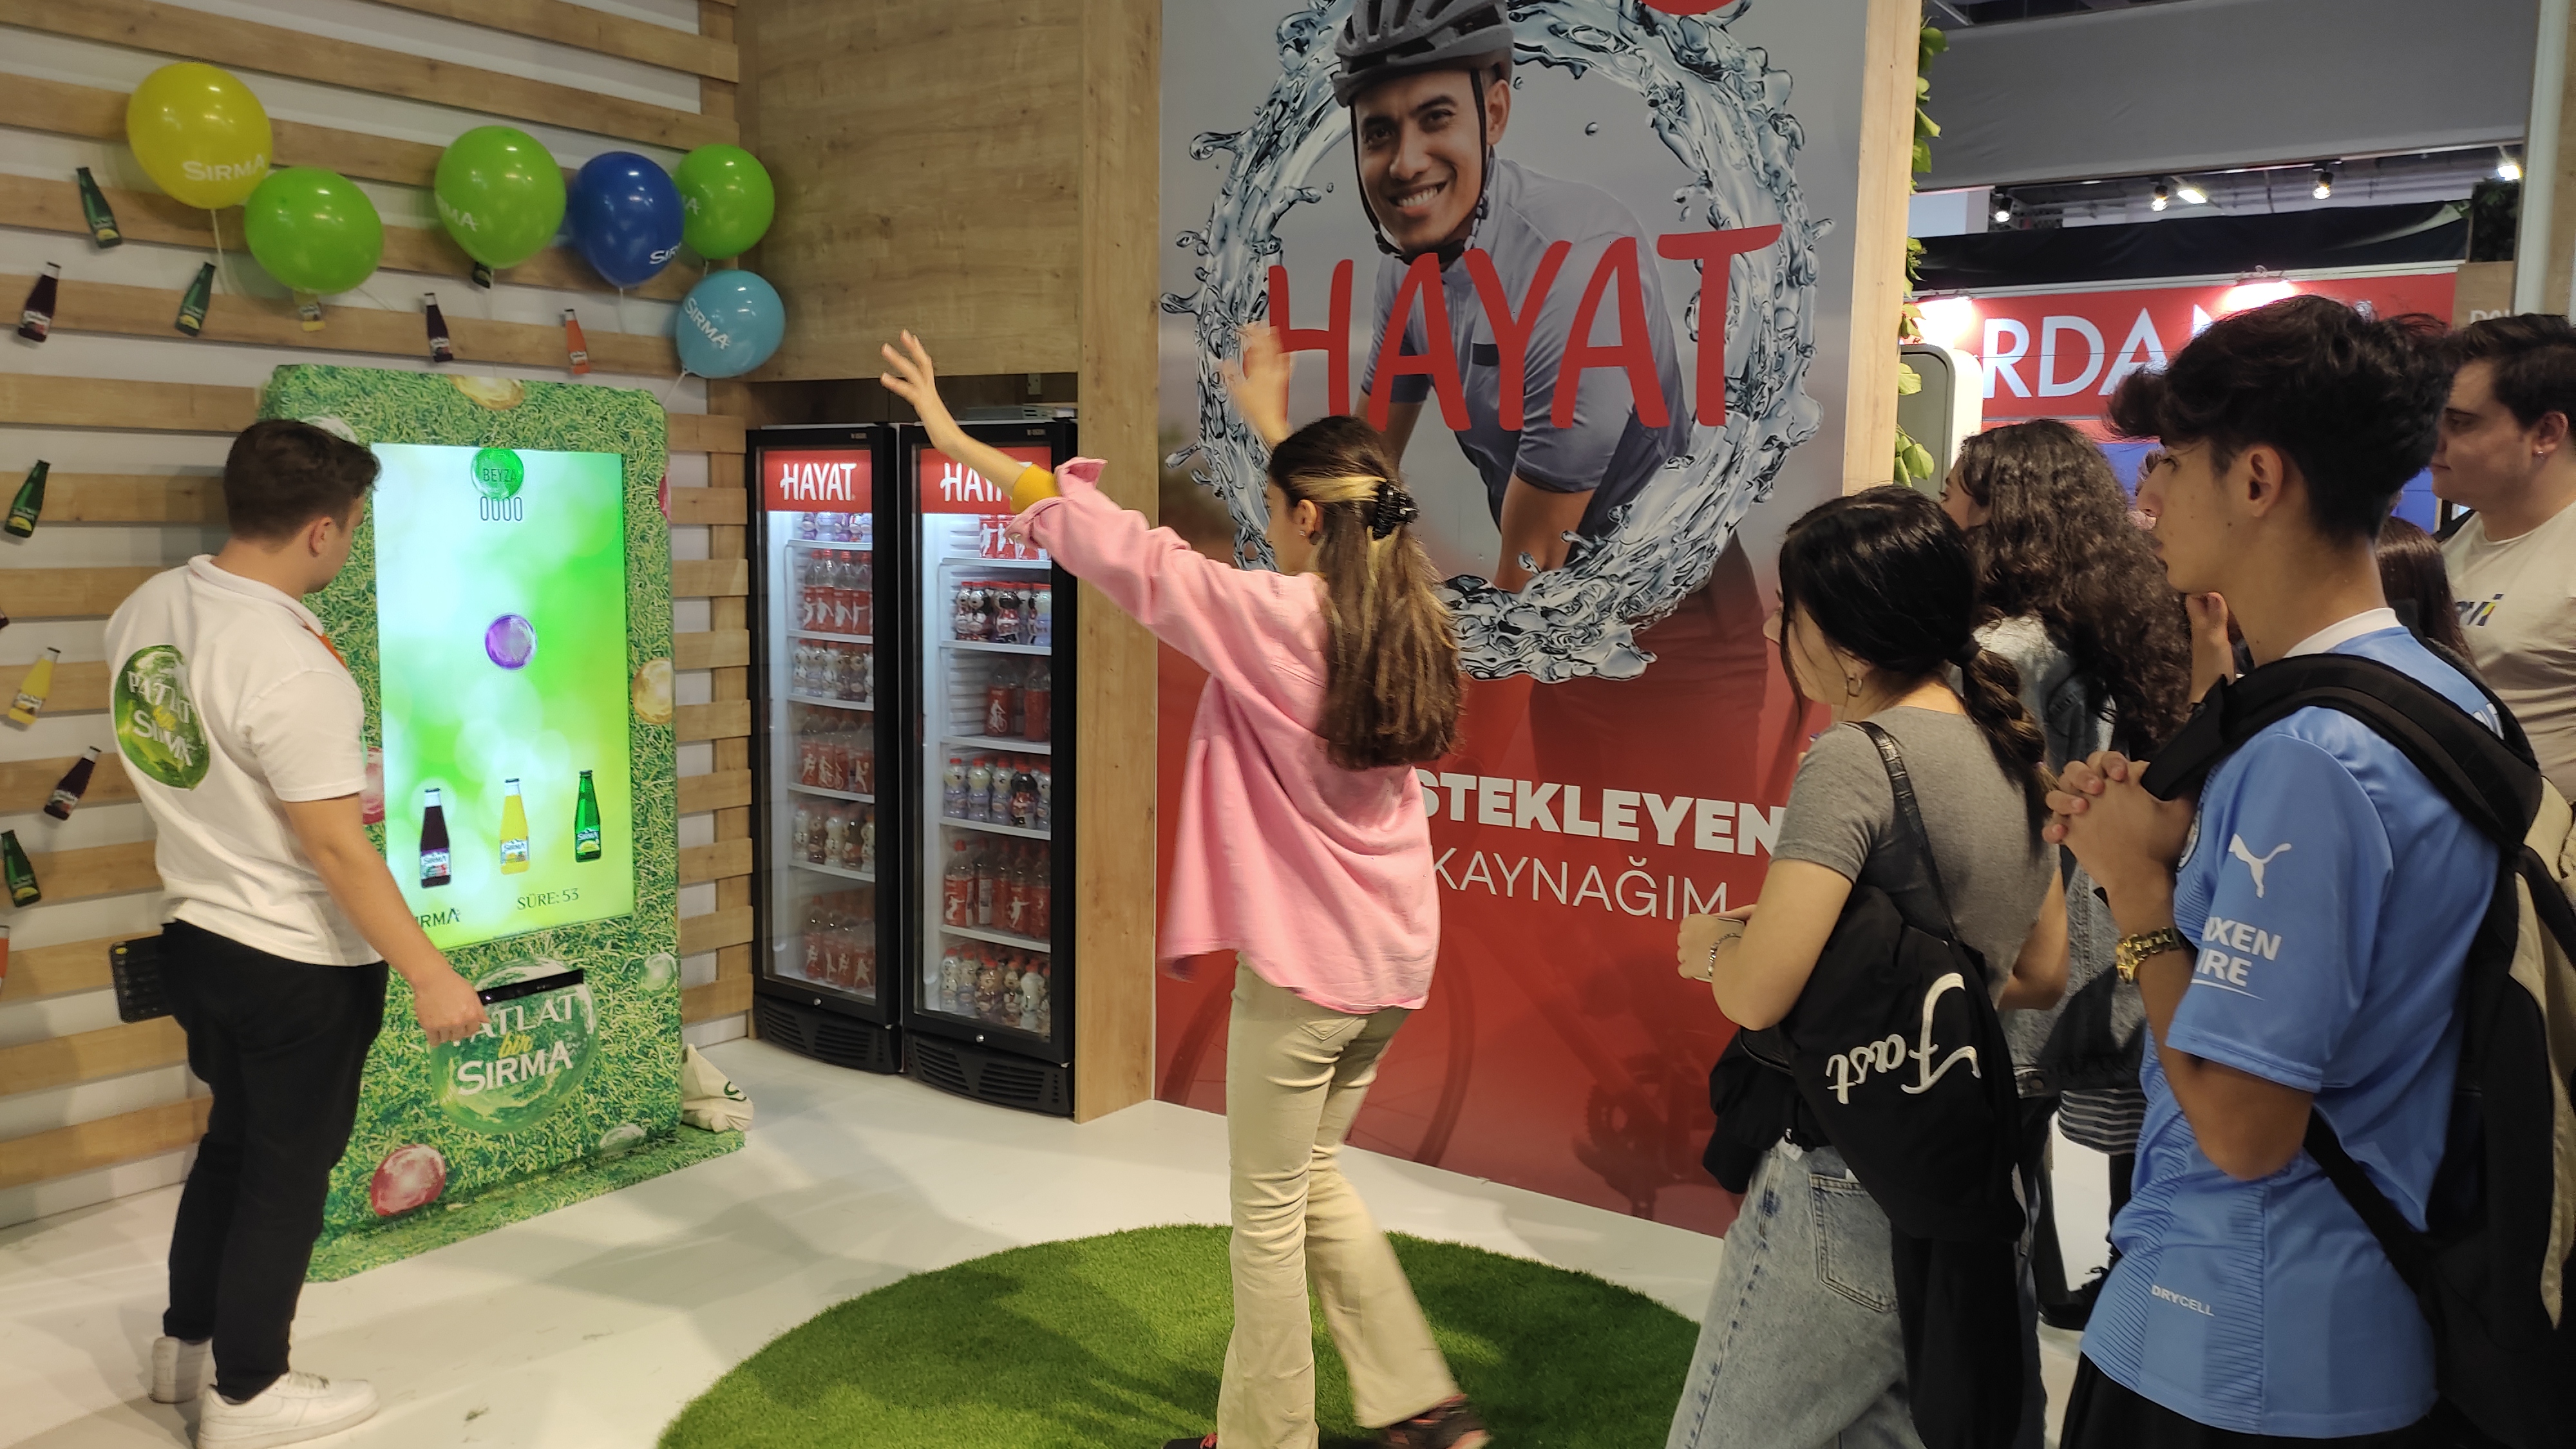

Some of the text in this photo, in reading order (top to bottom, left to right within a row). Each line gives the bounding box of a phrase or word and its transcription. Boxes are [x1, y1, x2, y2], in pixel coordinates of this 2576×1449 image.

[182, 154, 265, 181] SIRMA
[649, 242, 682, 265] SIR
[685, 298, 729, 350] SIRMA
[1248, 223, 1783, 432] HAYAT
[1983, 304, 2211, 398] RDA
[779, 463, 857, 501] HAYAT
[517, 887, 579, 910] SÜRE: 53
[453, 993, 578, 1046] ATLAT
[1825, 972, 1982, 1104] Fast
[457, 1040, 574, 1095] SIRMA
[2152, 1284, 2215, 1316] DRYCELL
